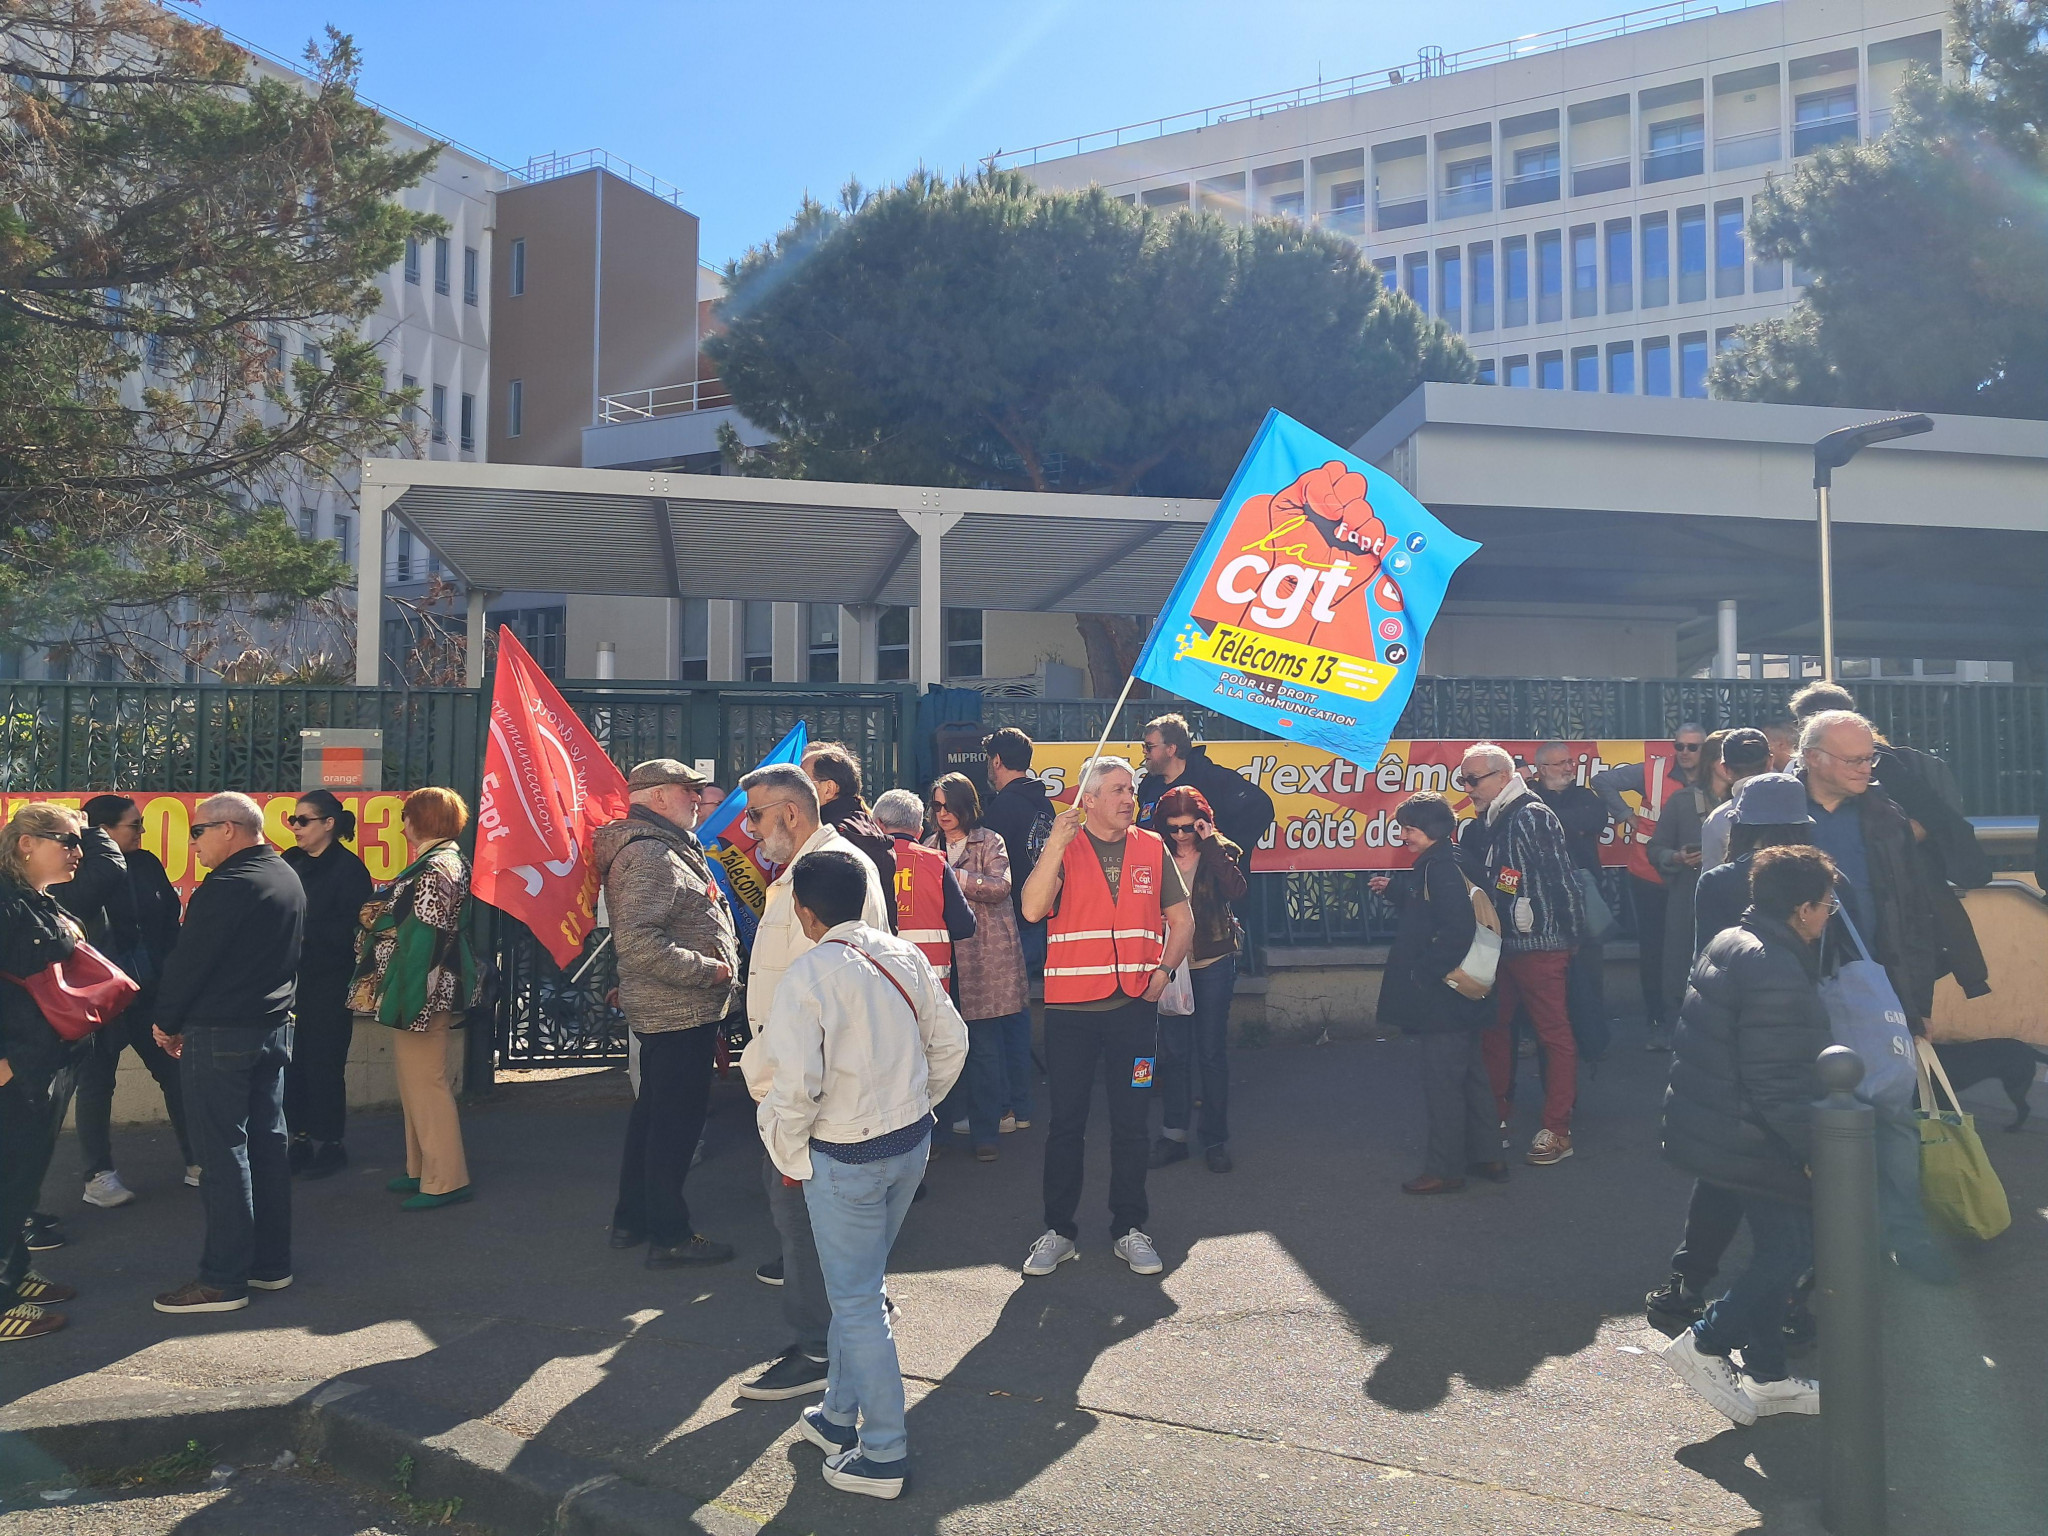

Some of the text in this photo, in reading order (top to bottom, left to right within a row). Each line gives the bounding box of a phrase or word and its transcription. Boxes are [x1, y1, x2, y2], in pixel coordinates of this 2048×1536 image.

[1241, 514, 1358, 570] la
[1335, 522, 1385, 556] fapt
[1216, 554, 1353, 629] cgt
[1212, 629, 1339, 684] Télécoms 13
[1213, 682, 1357, 726] À LA COMMUNICATION
[1220, 672, 1319, 704] POUR LE DROIT
[323, 775, 358, 784] orange
[492, 700, 553, 836] ommunication
[1257, 809, 1405, 850] u côté de
[720, 850, 766, 908] Télécoms
[1500, 873, 1519, 886] cgt
[1134, 1067, 1148, 1078] cgt
